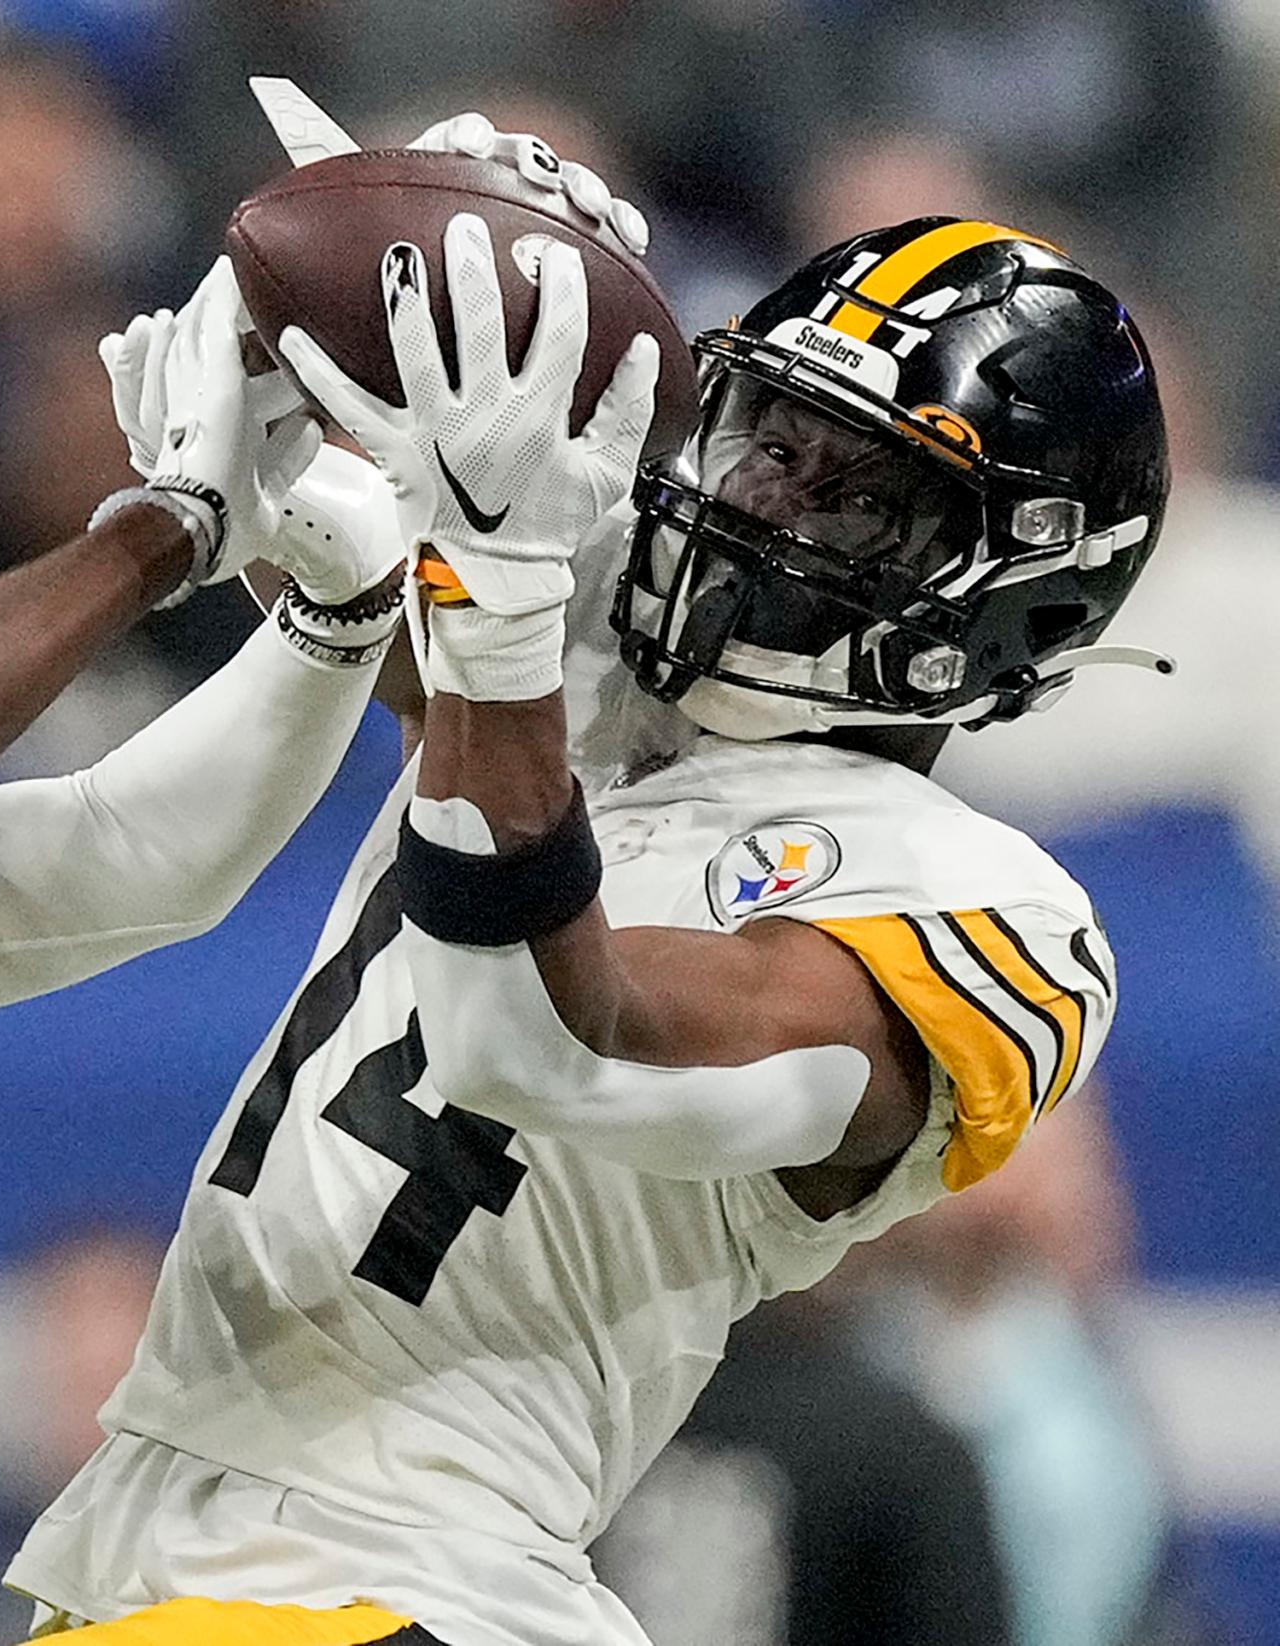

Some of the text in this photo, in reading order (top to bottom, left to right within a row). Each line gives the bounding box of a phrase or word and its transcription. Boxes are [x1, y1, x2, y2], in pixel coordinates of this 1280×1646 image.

[794, 324, 864, 369] Steelers
[809, 250, 963, 359] 14
[208, 860, 529, 1307] 14
